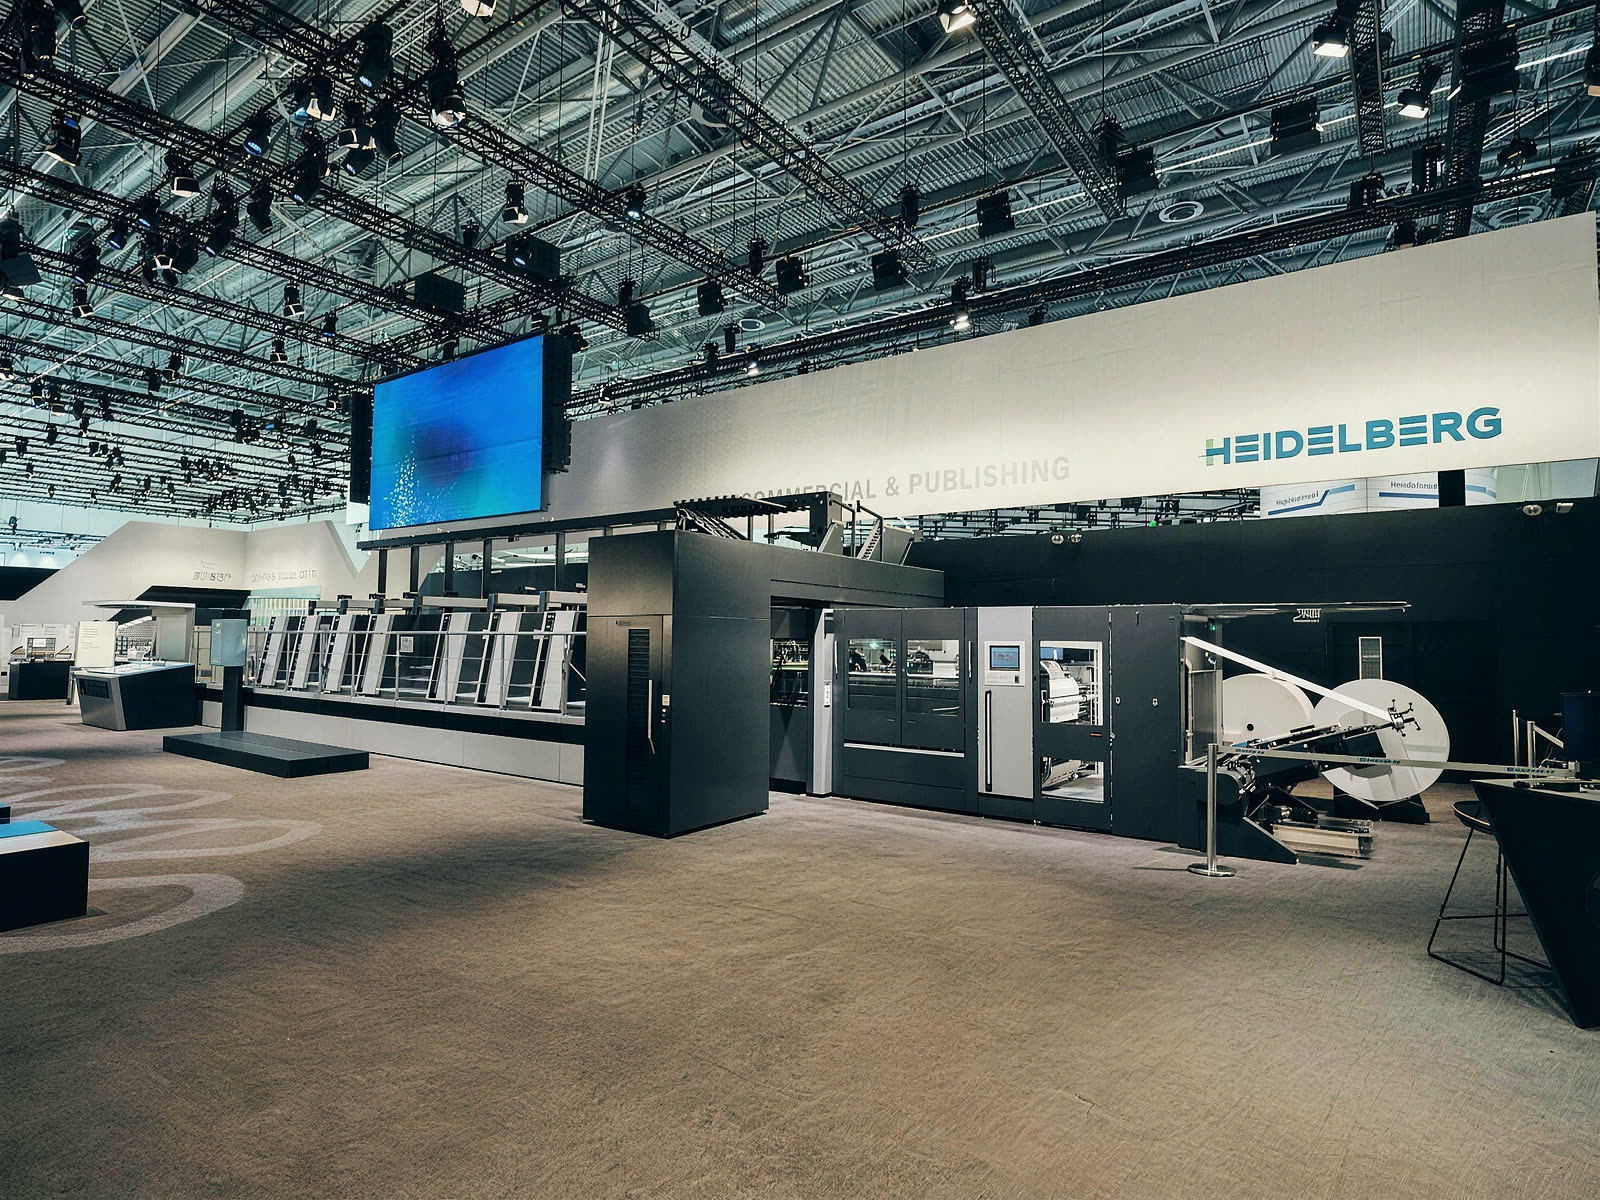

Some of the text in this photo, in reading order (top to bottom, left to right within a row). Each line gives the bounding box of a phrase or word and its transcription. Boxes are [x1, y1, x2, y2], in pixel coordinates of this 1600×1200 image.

[1204, 407, 1502, 466] HEIDELBERG
[885, 476, 900, 496] &
[909, 456, 1070, 495] PUBLISHING
